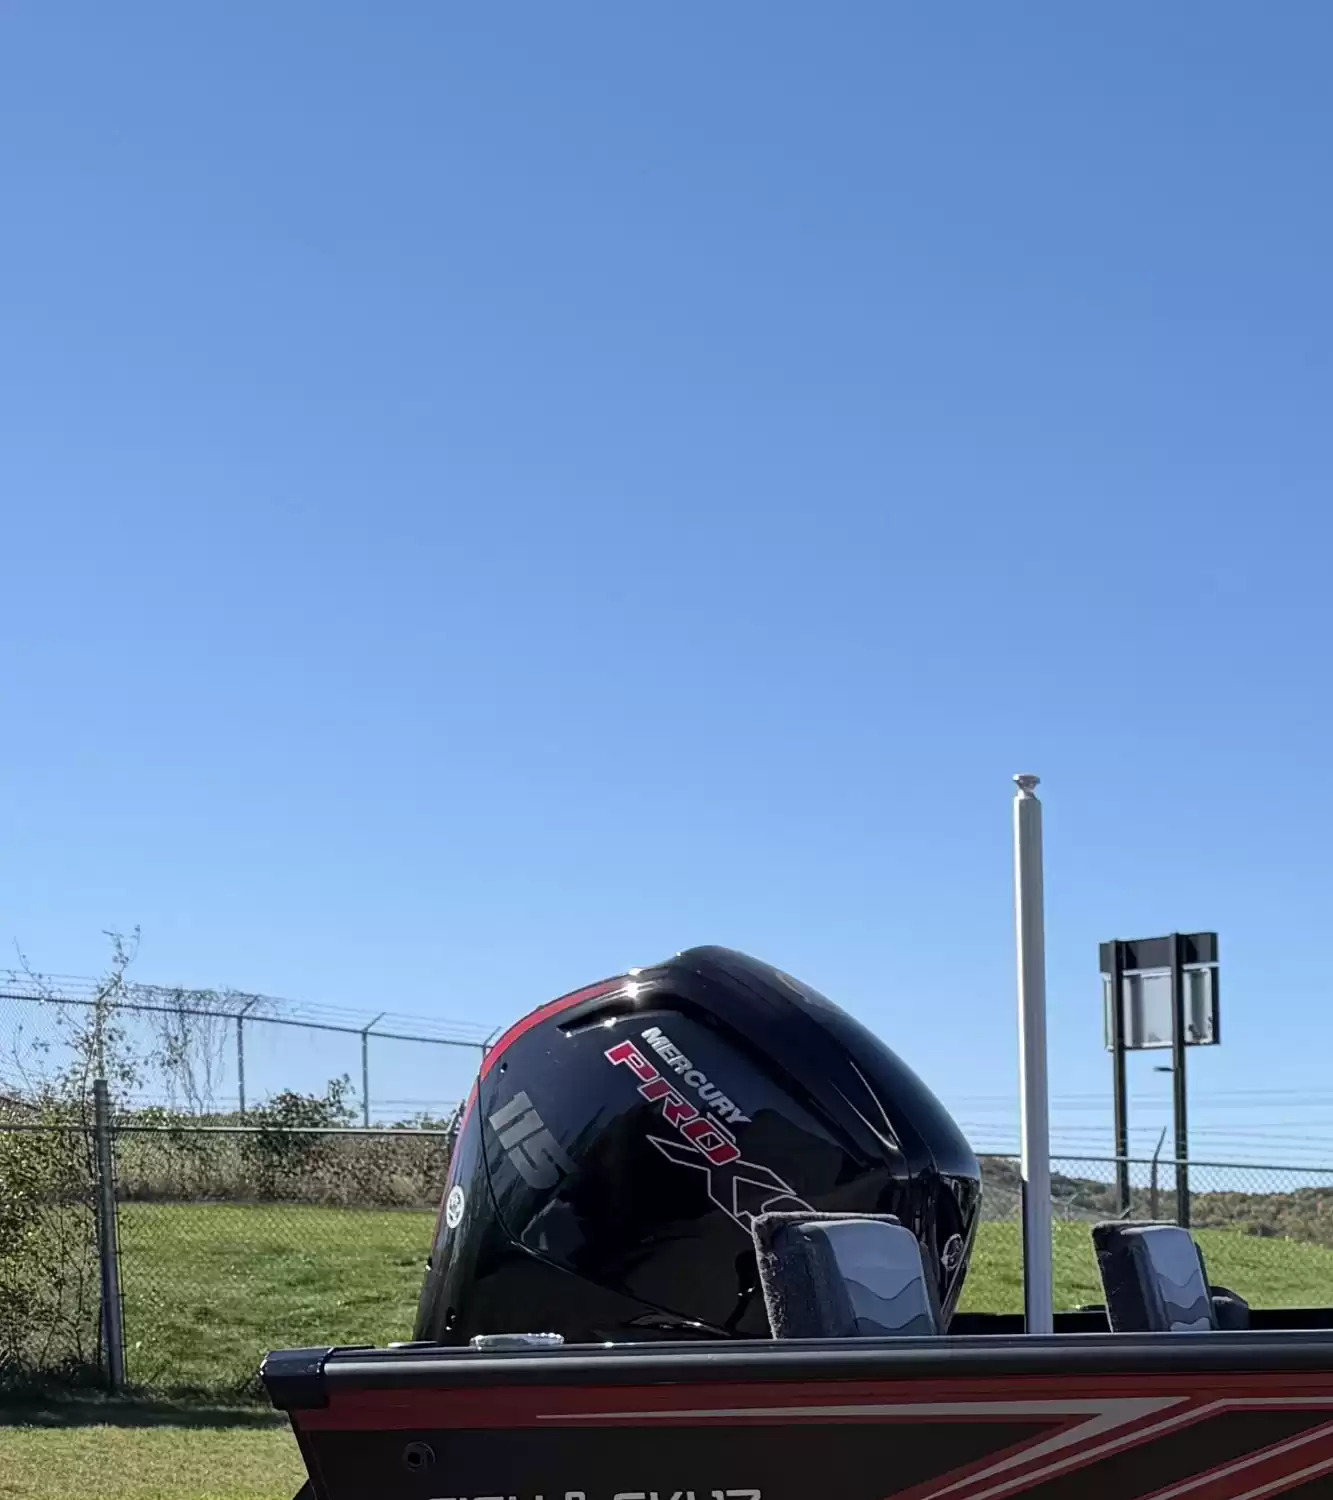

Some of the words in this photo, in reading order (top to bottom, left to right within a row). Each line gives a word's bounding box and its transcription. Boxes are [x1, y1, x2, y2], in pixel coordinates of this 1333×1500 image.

[605, 1039, 741, 1166] PRO
[641, 1026, 752, 1124] MERCURY
[489, 1090, 578, 1190] 115
